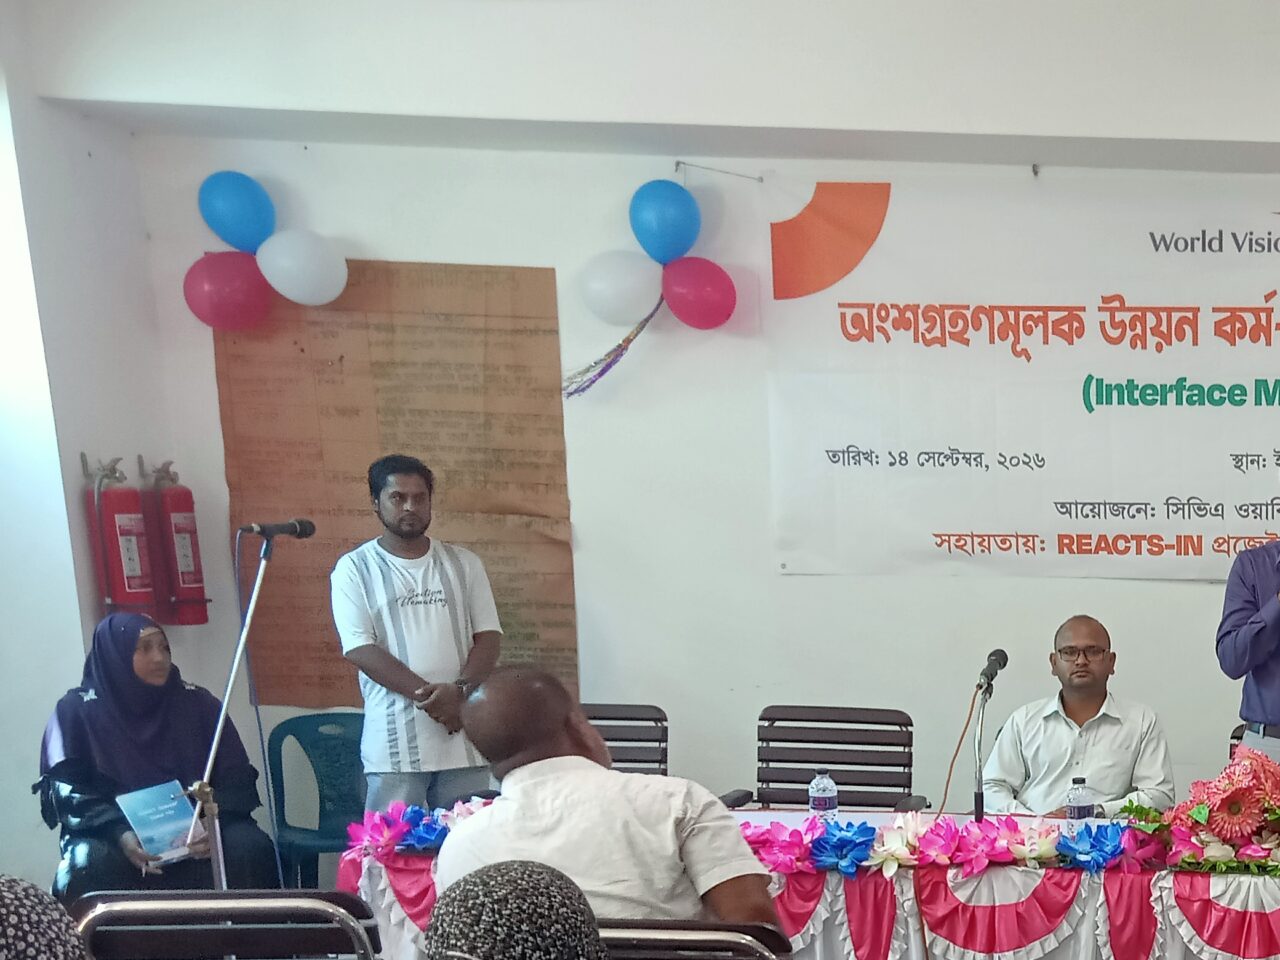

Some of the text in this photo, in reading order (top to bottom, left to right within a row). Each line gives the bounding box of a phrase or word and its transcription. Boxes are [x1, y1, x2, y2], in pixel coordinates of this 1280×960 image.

[1149, 229, 1223, 253] World
[838, 302, 1086, 363] অংশগ্রহণমূলক
[1097, 294, 1200, 354] উন্নয়ন
[1082, 373, 1248, 414] (Interface
[888, 450, 909, 467] ১৪
[917, 446, 990, 472] সেপ্টেম্বর,
[997, 452, 1046, 471] ২০২৬
[1163, 496, 1225, 520] সিভিএ
[1056, 533, 1204, 557] REACTS-IN
